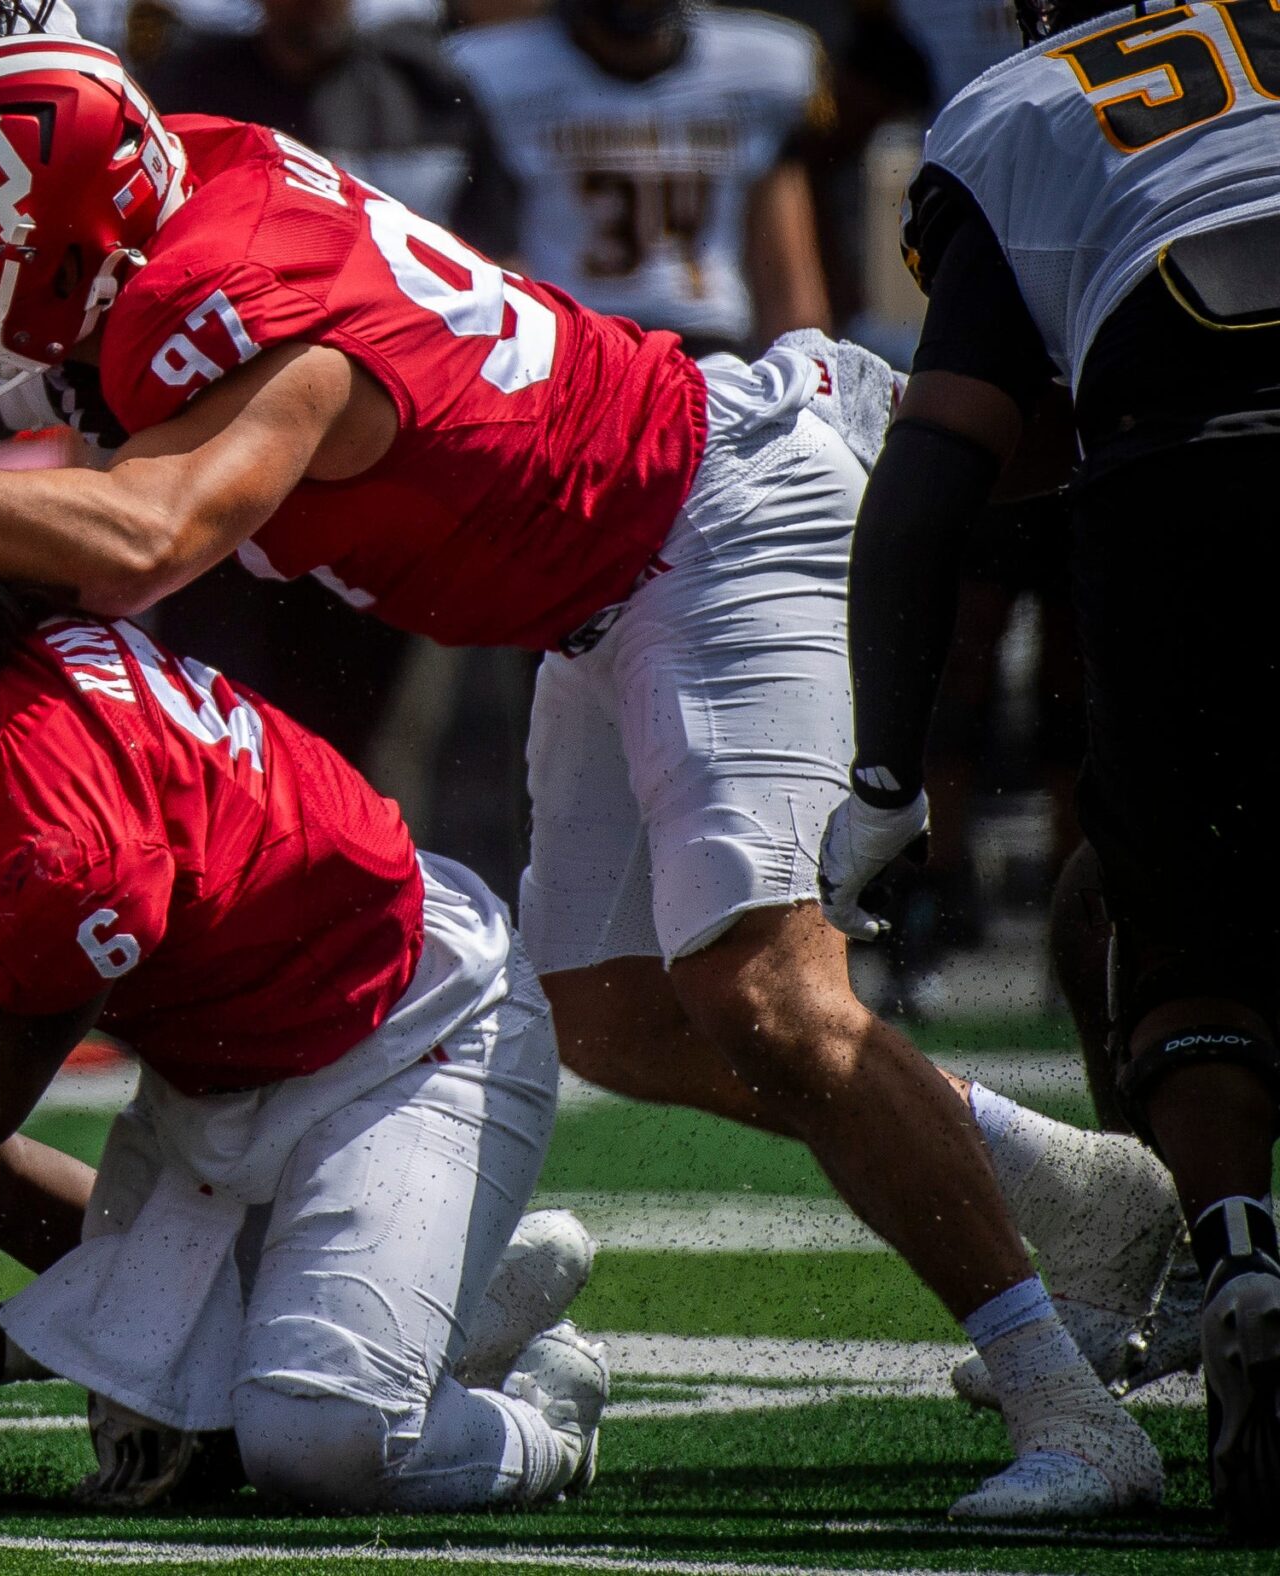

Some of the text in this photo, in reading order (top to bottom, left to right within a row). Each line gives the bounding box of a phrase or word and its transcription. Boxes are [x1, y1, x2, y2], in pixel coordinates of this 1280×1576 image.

[360, 185, 556, 394] 9
[151, 289, 261, 399] 97
[76, 908, 141, 978] 6
[1165, 1034, 1252, 1052] DONJOY
